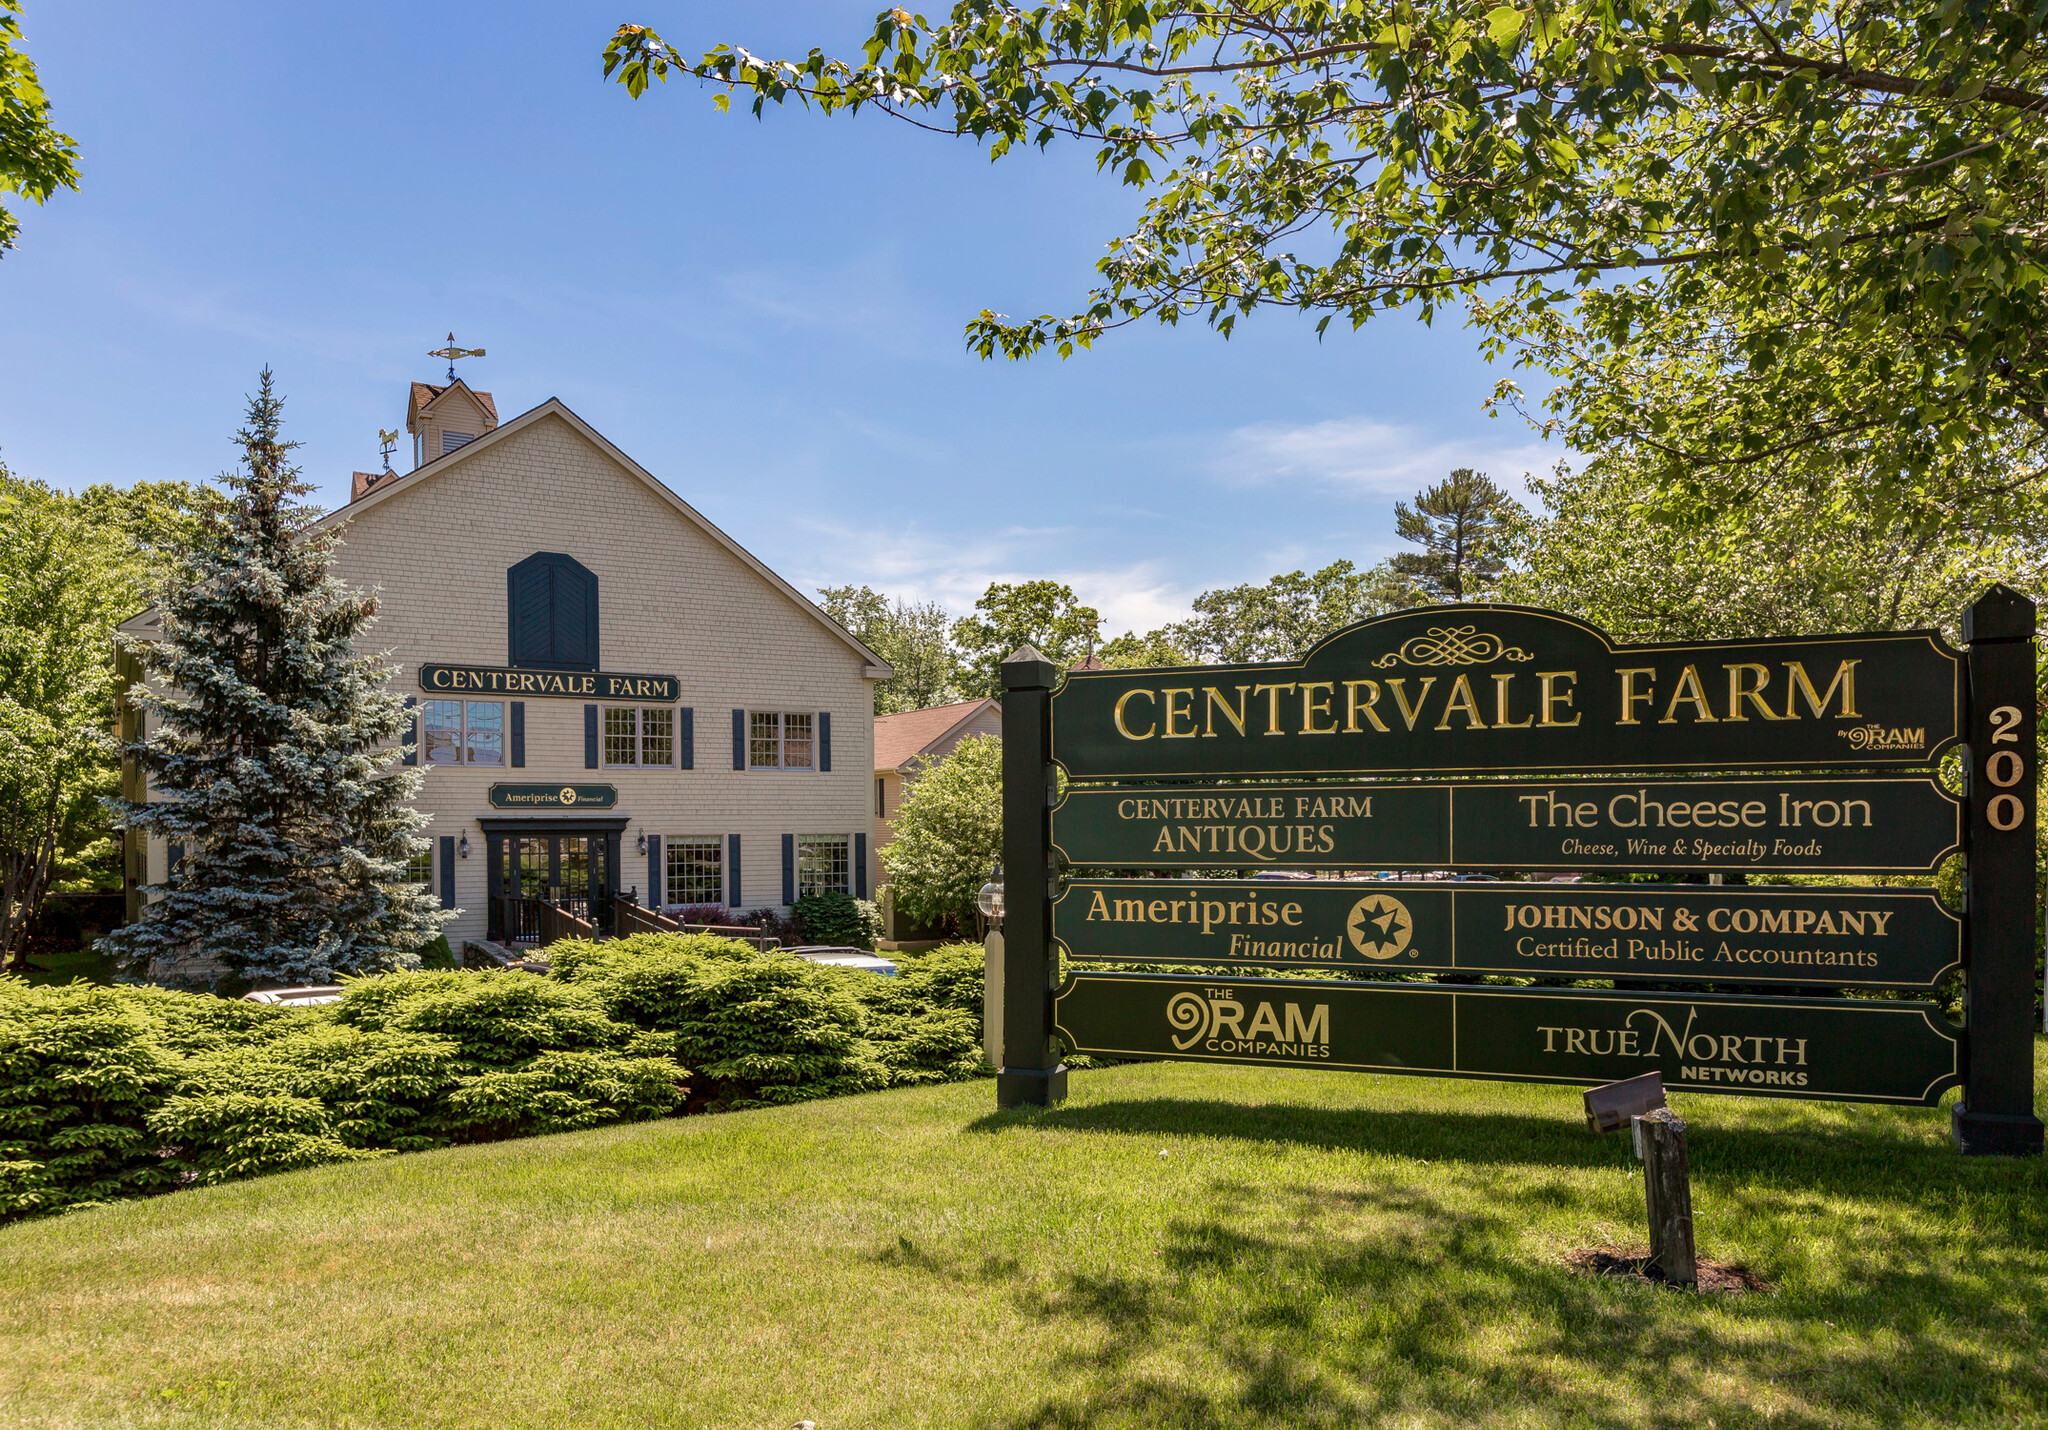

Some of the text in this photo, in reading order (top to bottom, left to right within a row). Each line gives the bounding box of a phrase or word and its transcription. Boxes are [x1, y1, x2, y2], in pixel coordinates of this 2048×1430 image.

[433, 669, 669, 698] CENTERVALE FARM
[1114, 659, 1863, 741] CENTERVALE FARM
[1838, 730, 1848, 739] By
[1868, 727, 1925, 744] RAM
[1986, 706, 2024, 831] 200
[505, 793, 558, 804] Ameriprise
[1118, 797, 1373, 820] CENTERVALE FARM
[1519, 789, 1873, 828] The Cheese Iron
[1153, 825, 1335, 860] ANTIQUES
[1561, 839, 1822, 862] Cheese, Wine & Specialty Foods
[1086, 890, 1303, 935] Ameriprise
[1504, 903, 1894, 936] JOHNSON & COMPANY
[1229, 933, 1343, 959] Financial
[1516, 936, 1878, 968] Certified Public Accountants
[1206, 988, 1233, 1000] THE
[1208, 1000, 1329, 1045] RAM
[1206, 1039, 1330, 1059] COMPANIES
[1681, 1065, 1808, 1086] NETWORKS
